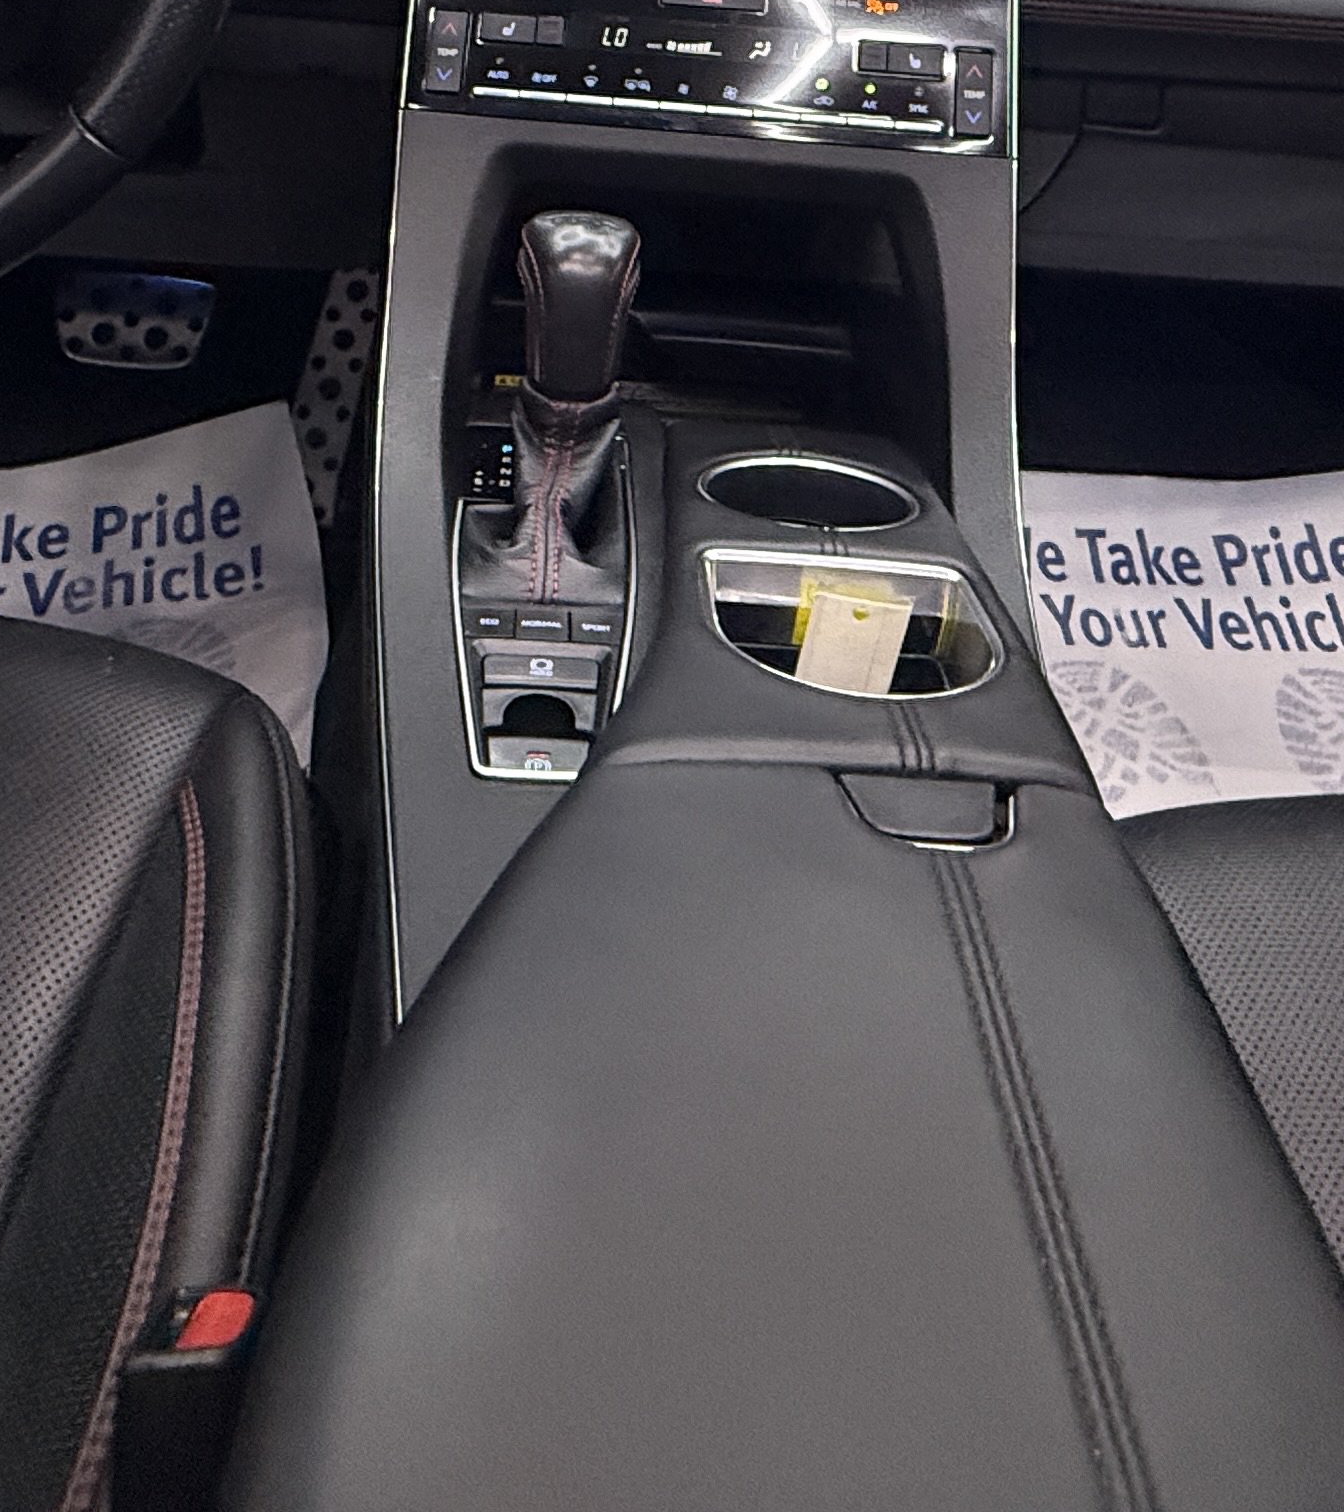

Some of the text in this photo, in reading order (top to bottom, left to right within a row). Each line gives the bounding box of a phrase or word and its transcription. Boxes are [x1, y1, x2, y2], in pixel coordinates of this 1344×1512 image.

[963, 89, 986, 100] TEMP
[92, 485, 242, 554] Pride
[23, 545, 265, 618] Vehicle!
[1024, 526, 1066, 584] e
[1075, 527, 1203, 587] Take
[1038, 594, 1167, 649] Your
